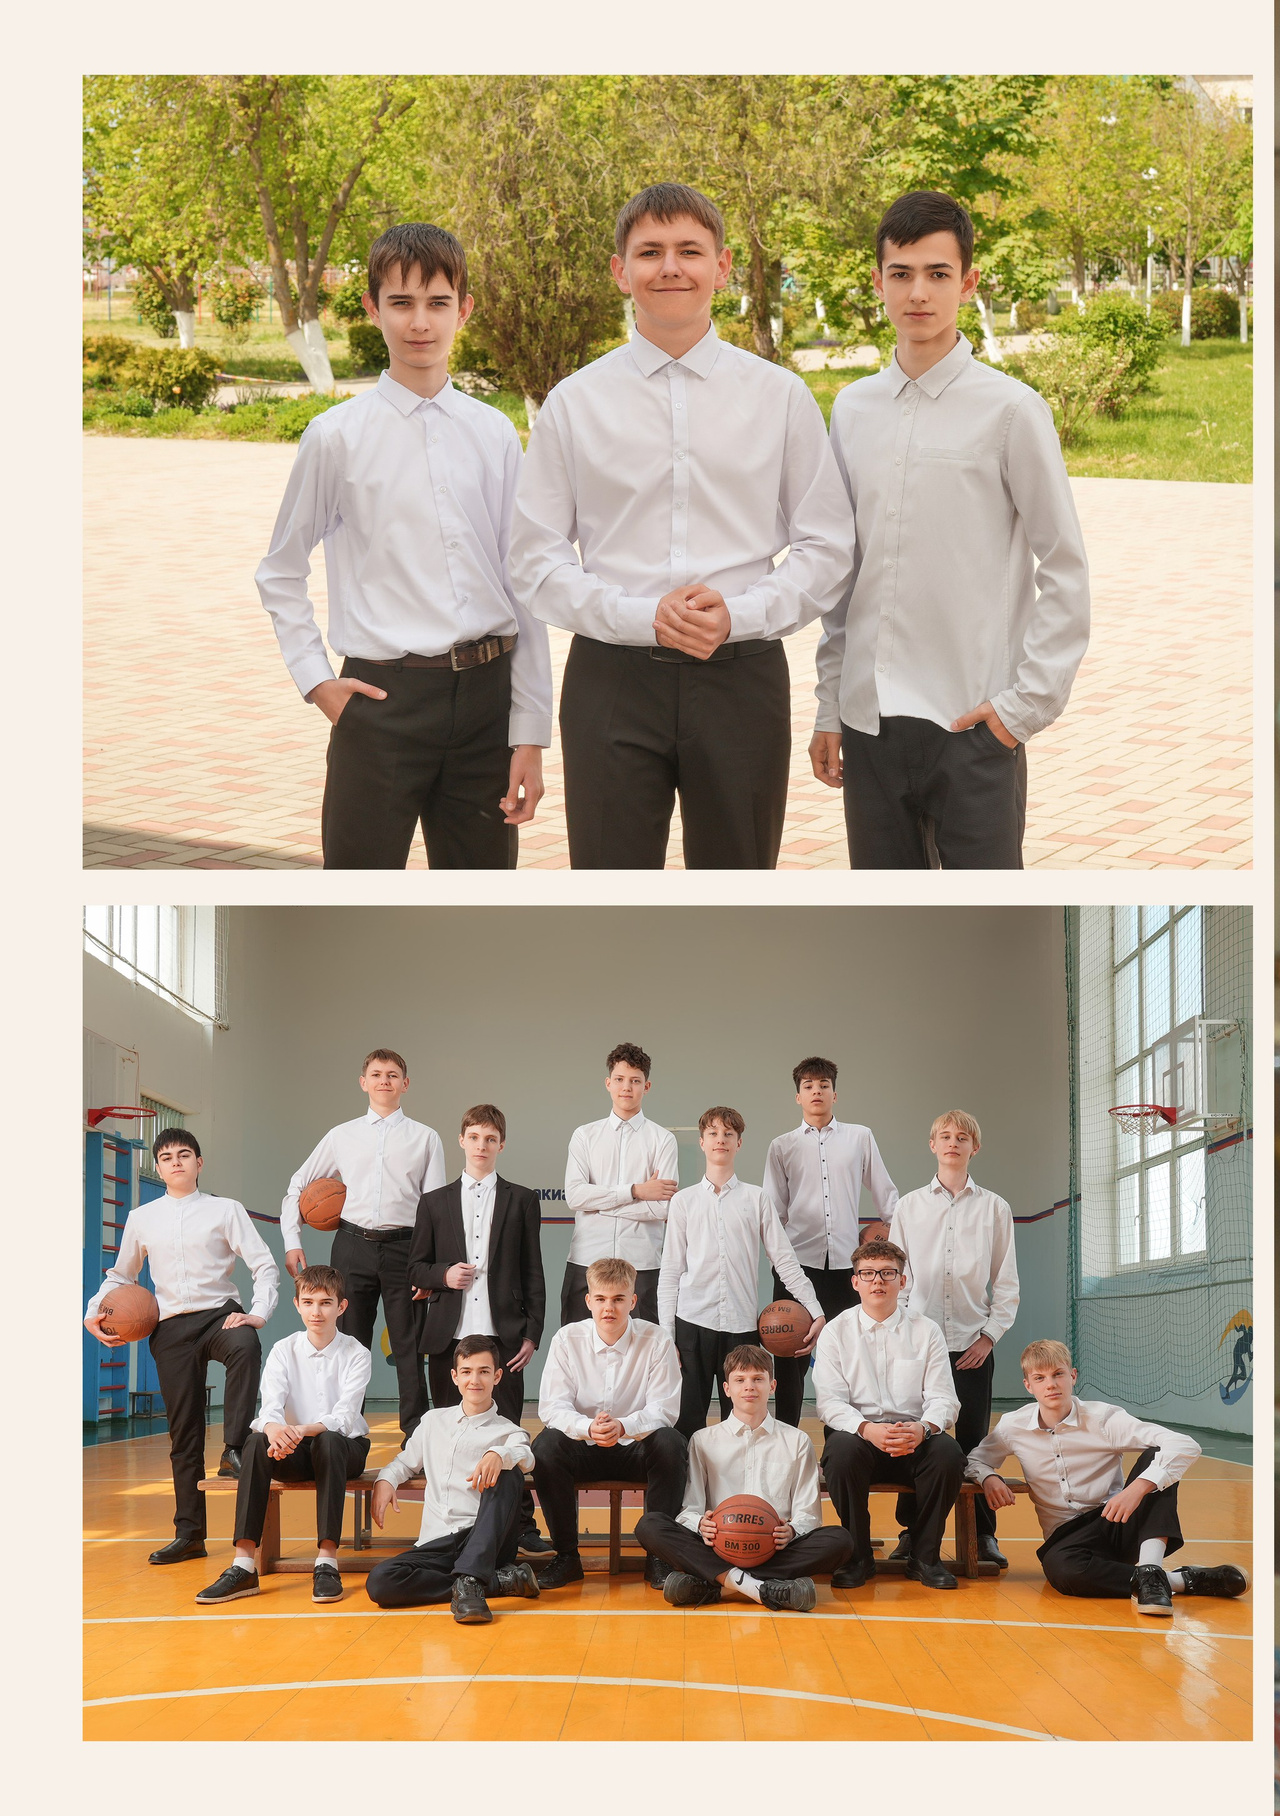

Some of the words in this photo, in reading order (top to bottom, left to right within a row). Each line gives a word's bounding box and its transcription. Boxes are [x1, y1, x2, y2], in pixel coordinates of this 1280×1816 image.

[761, 1324, 795, 1335] TORRES
[722, 1513, 765, 1526] TORRES
[725, 1540, 740, 1550] BM
[742, 1542, 761, 1551] 300
